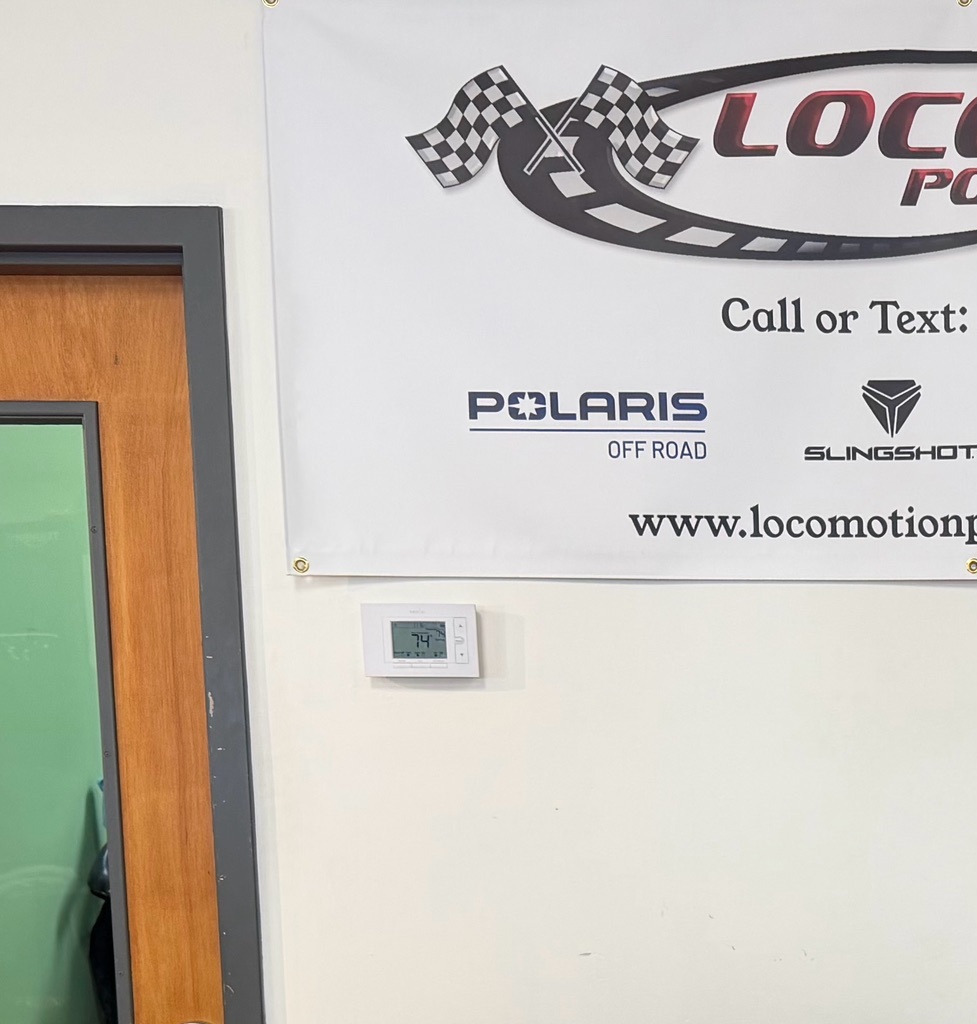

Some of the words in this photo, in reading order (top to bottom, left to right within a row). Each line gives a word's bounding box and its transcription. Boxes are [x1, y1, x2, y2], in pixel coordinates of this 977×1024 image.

[721, 297, 804, 334] Call
[816, 309, 858, 334] or
[869, 300, 968, 334] Text:
[468, 391, 707, 421] POLARIS
[608, 440, 647, 459] OFF
[652, 440, 707, 459] ROAD
